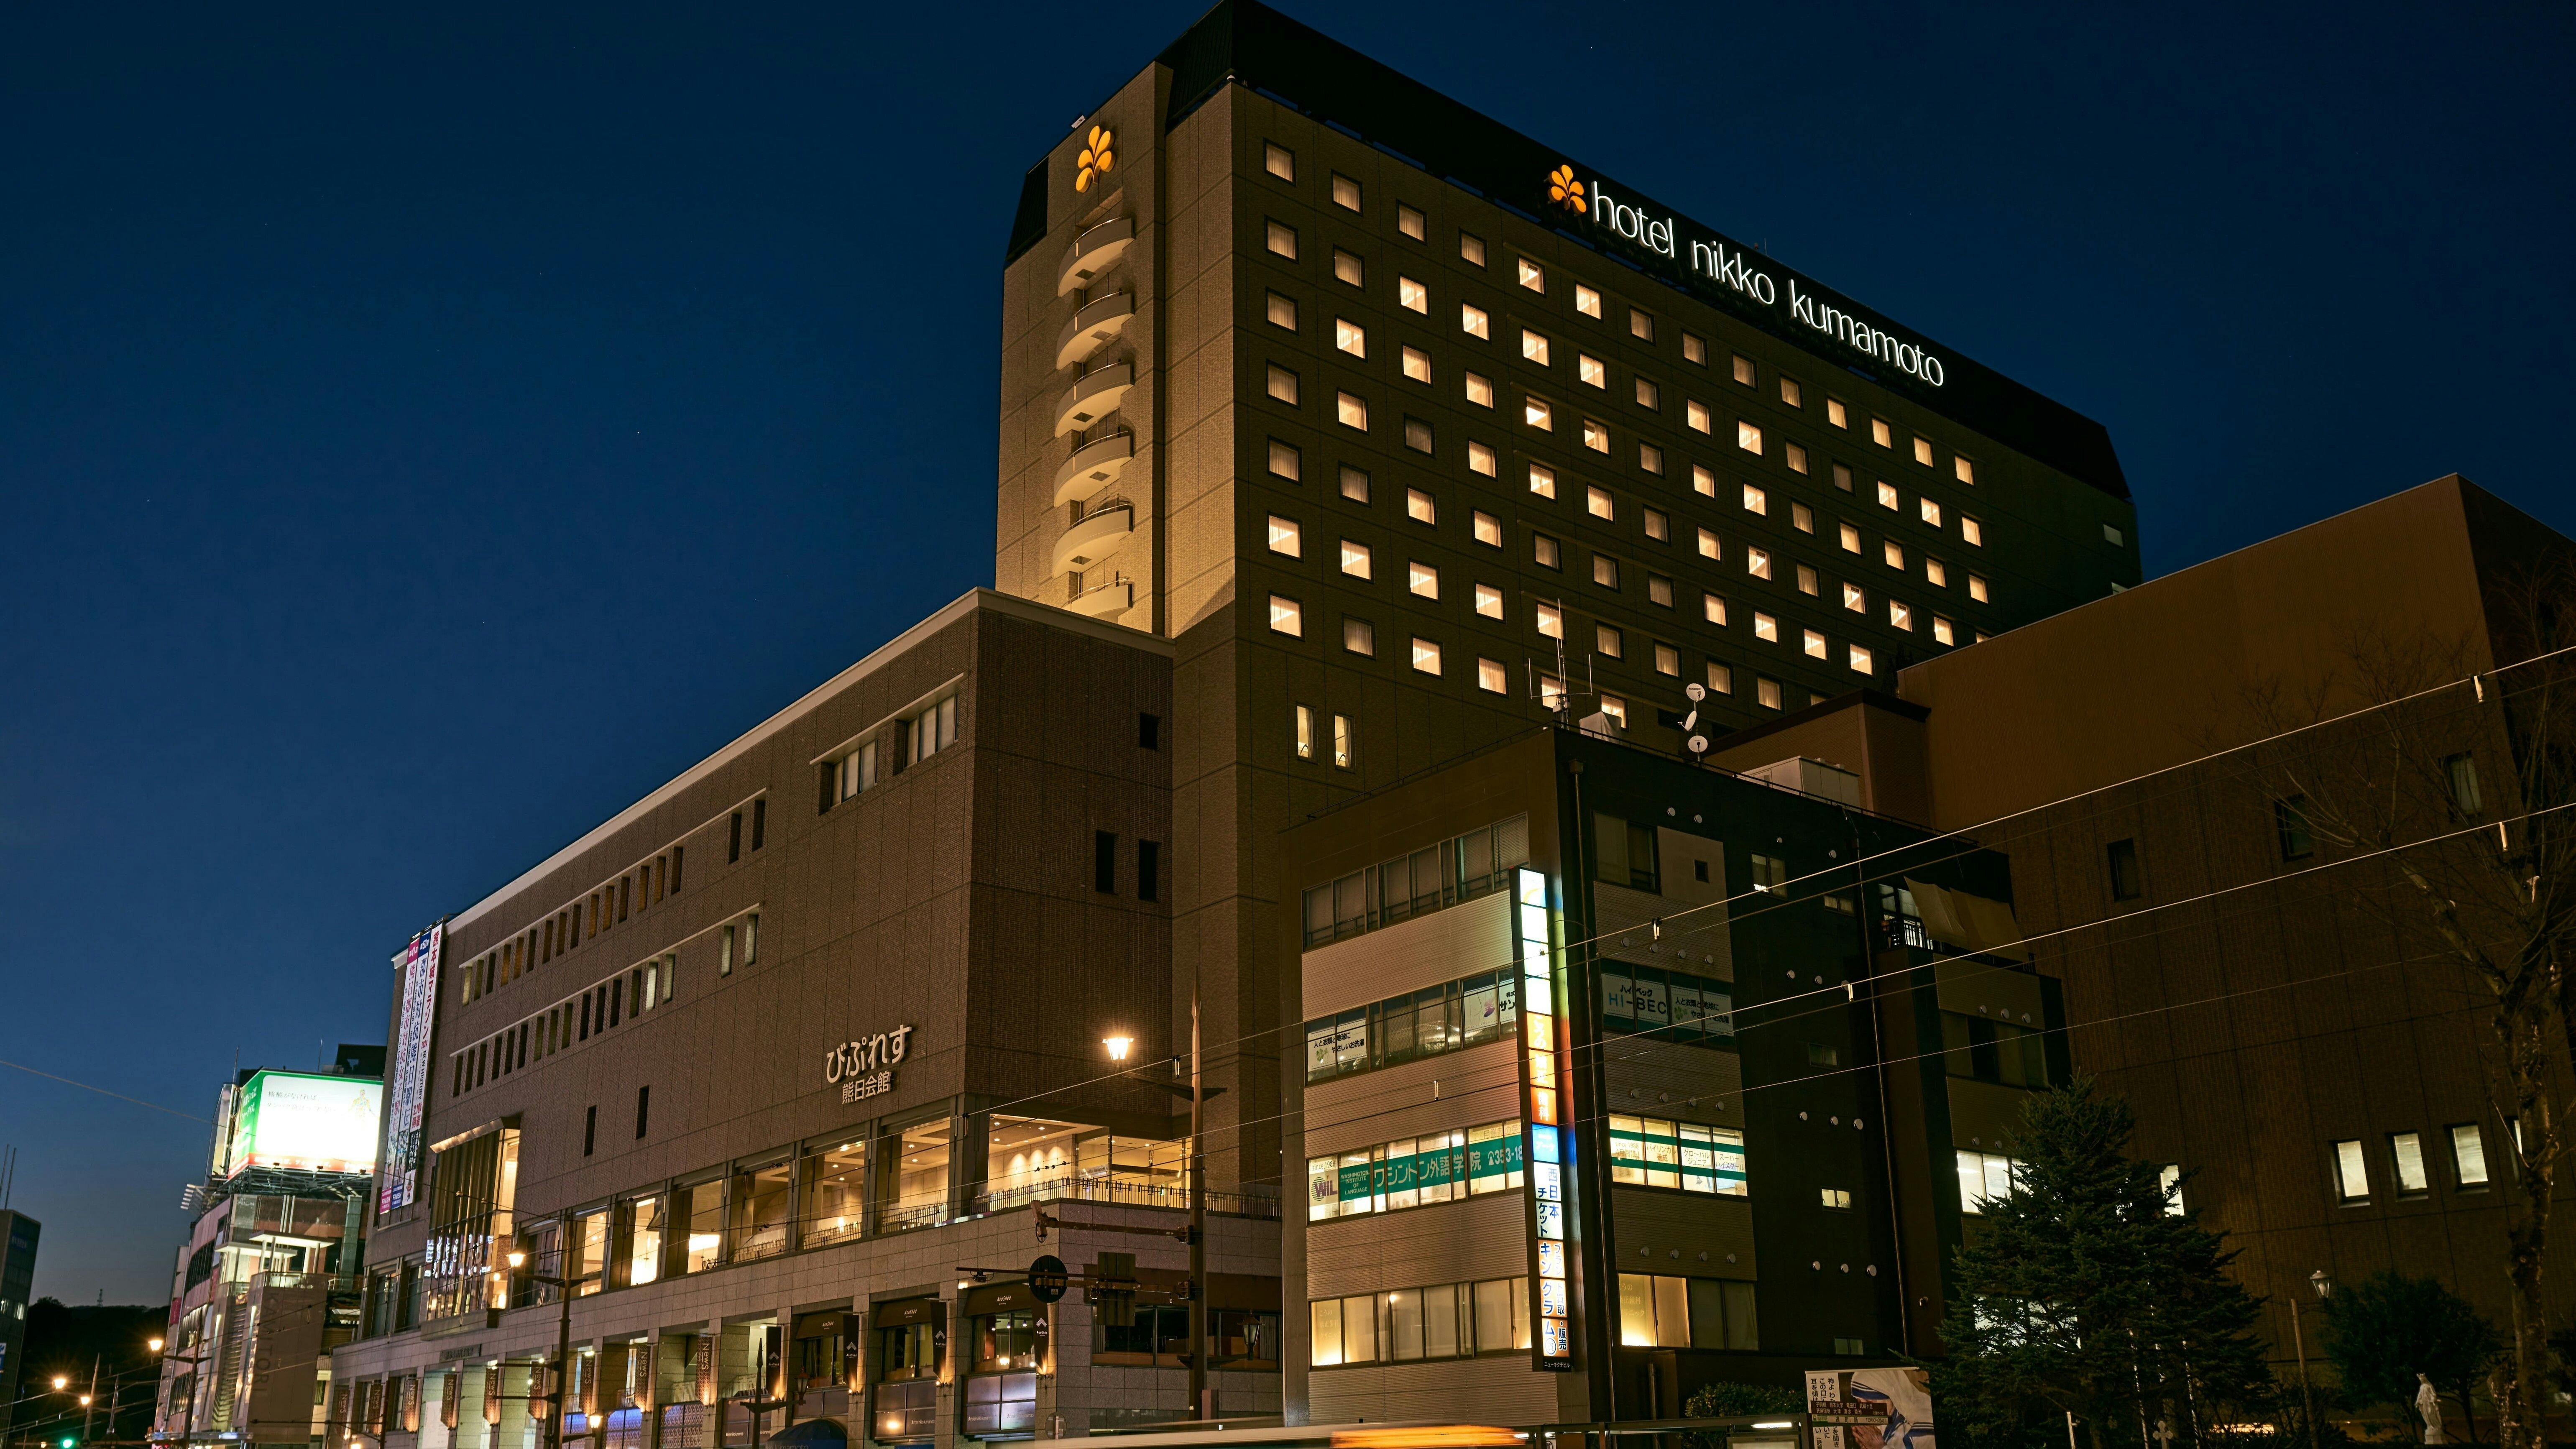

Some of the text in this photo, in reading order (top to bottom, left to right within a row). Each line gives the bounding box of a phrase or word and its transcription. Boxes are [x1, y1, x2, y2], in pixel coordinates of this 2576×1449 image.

[1590, 180, 1944, 388] hotel nikko kumamoto
[423, 930, 439, 1040] 熊本城マラソン
[1620, 984, 1653, 997] ハイベック
[1608, 992, 1668, 1015] HI-BEC
[1314, 1032, 1351, 1048] 人と衣類と地球に
[1331, 1038, 1365, 1053] やさしいお洗濯
[826, 1024, 912, 1084] びぷれす
[842, 1070, 892, 1105] 熊日会館
[1324, 1160, 1336, 1169] 1988
[1341, 1170, 1369, 1179] WASHINGTON
[1374, 1150, 1481, 1188] ワシントン外語学院
[1345, 1176, 1367, 1184] INSTITUTE
[1548, 1168, 1559, 1219] 西日本
[1538, 1187, 1548, 1237] チケット
[1827, 1378, 1835, 1390] 神よ
